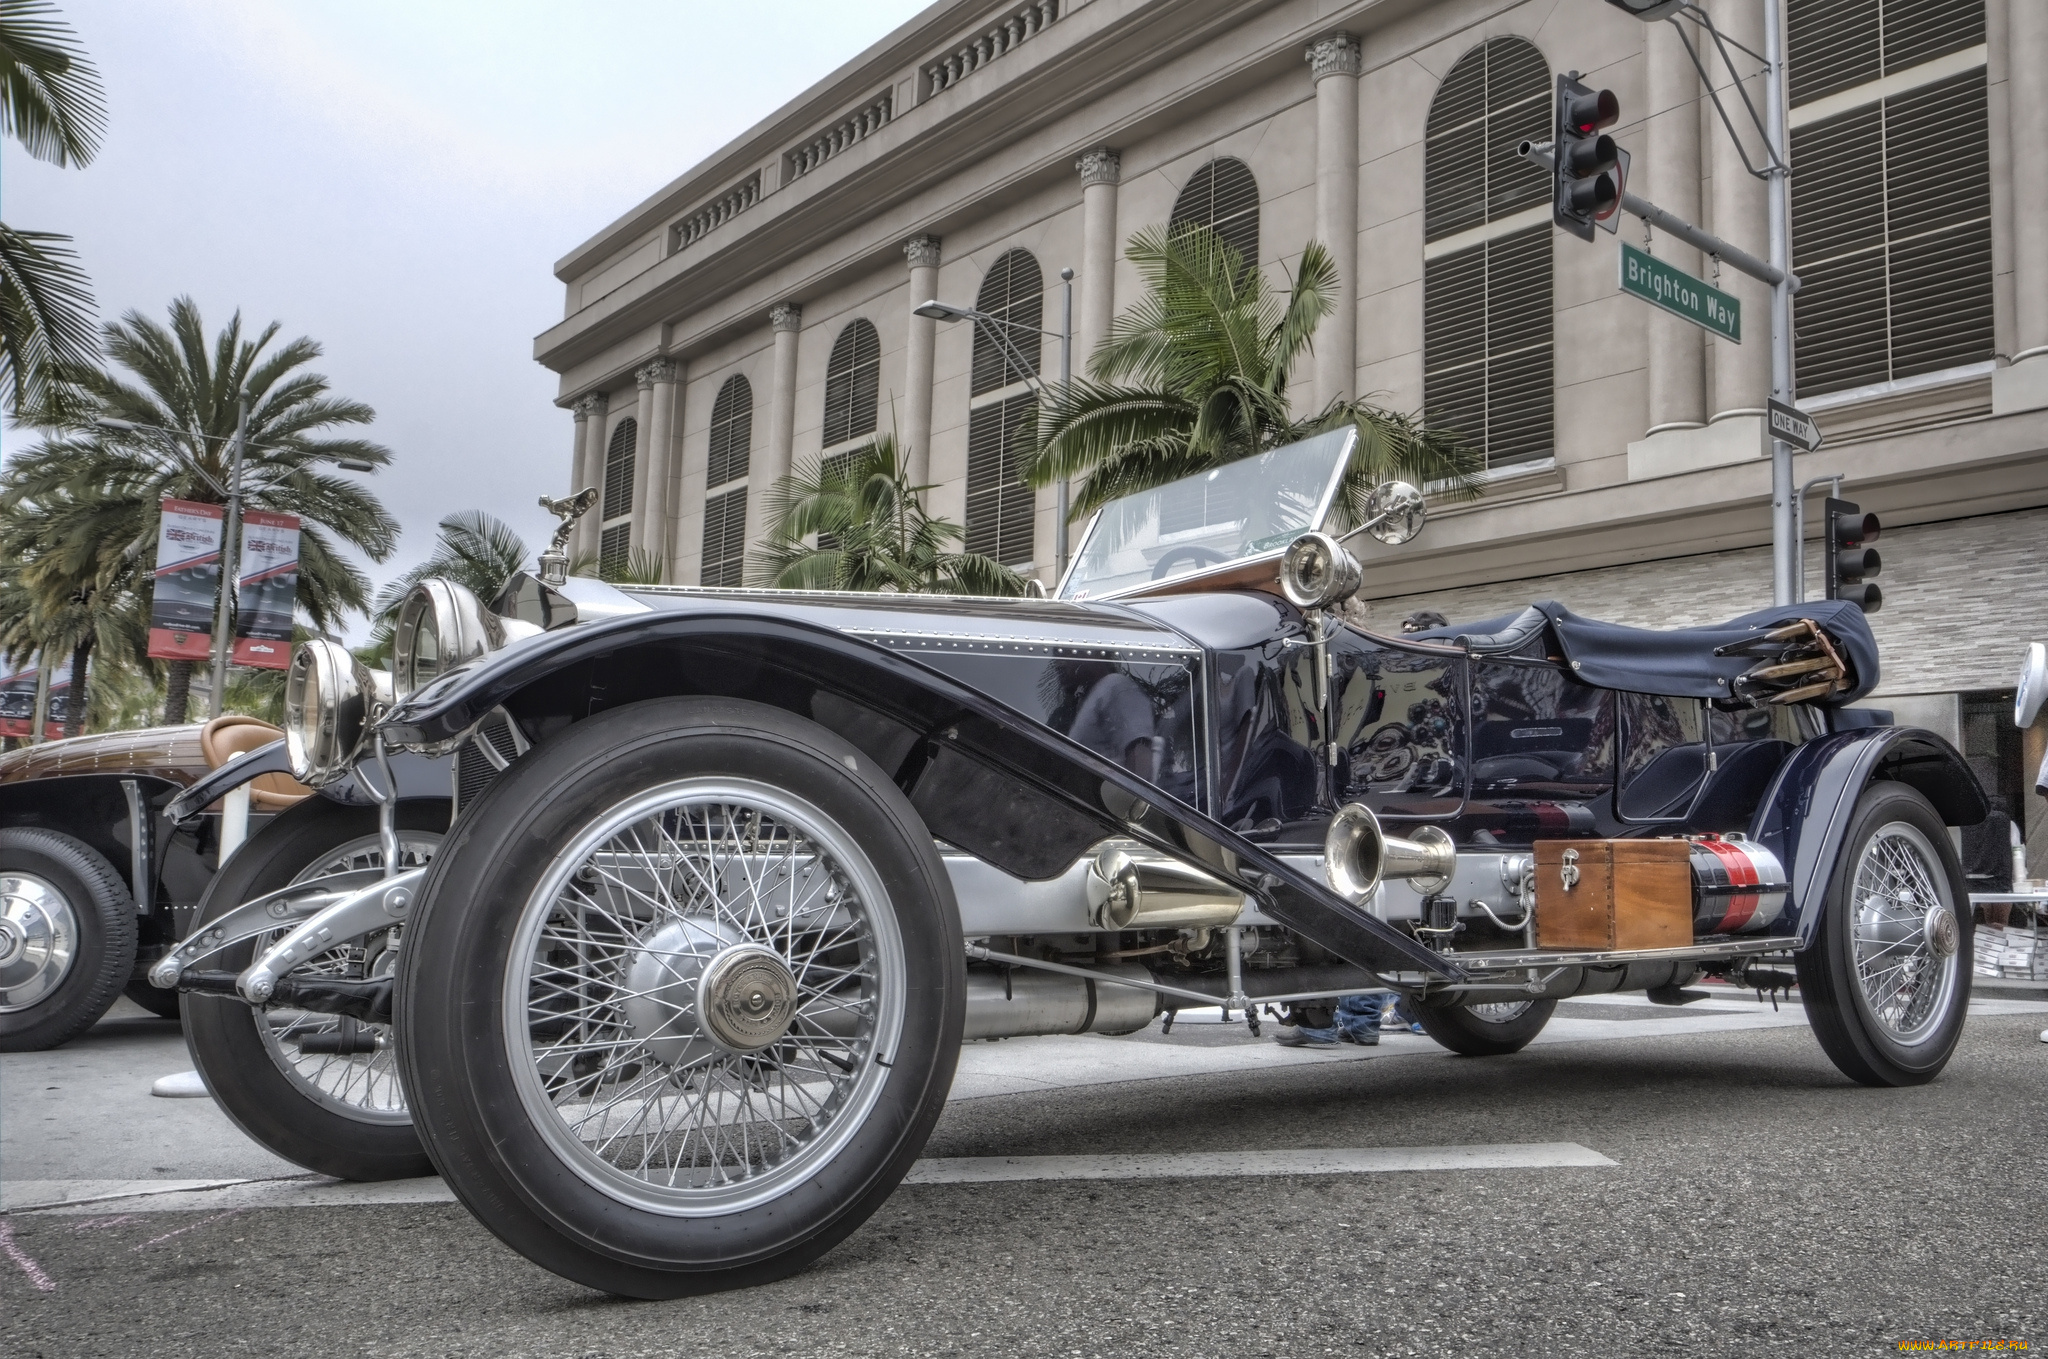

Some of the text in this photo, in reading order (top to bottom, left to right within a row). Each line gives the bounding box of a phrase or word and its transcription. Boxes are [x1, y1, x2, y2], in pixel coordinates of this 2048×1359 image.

[1628, 256, 1736, 333] Brighton Way
[1774, 411, 1808, 438] ONE WAY
[260, 517, 276, 525] JUNE
